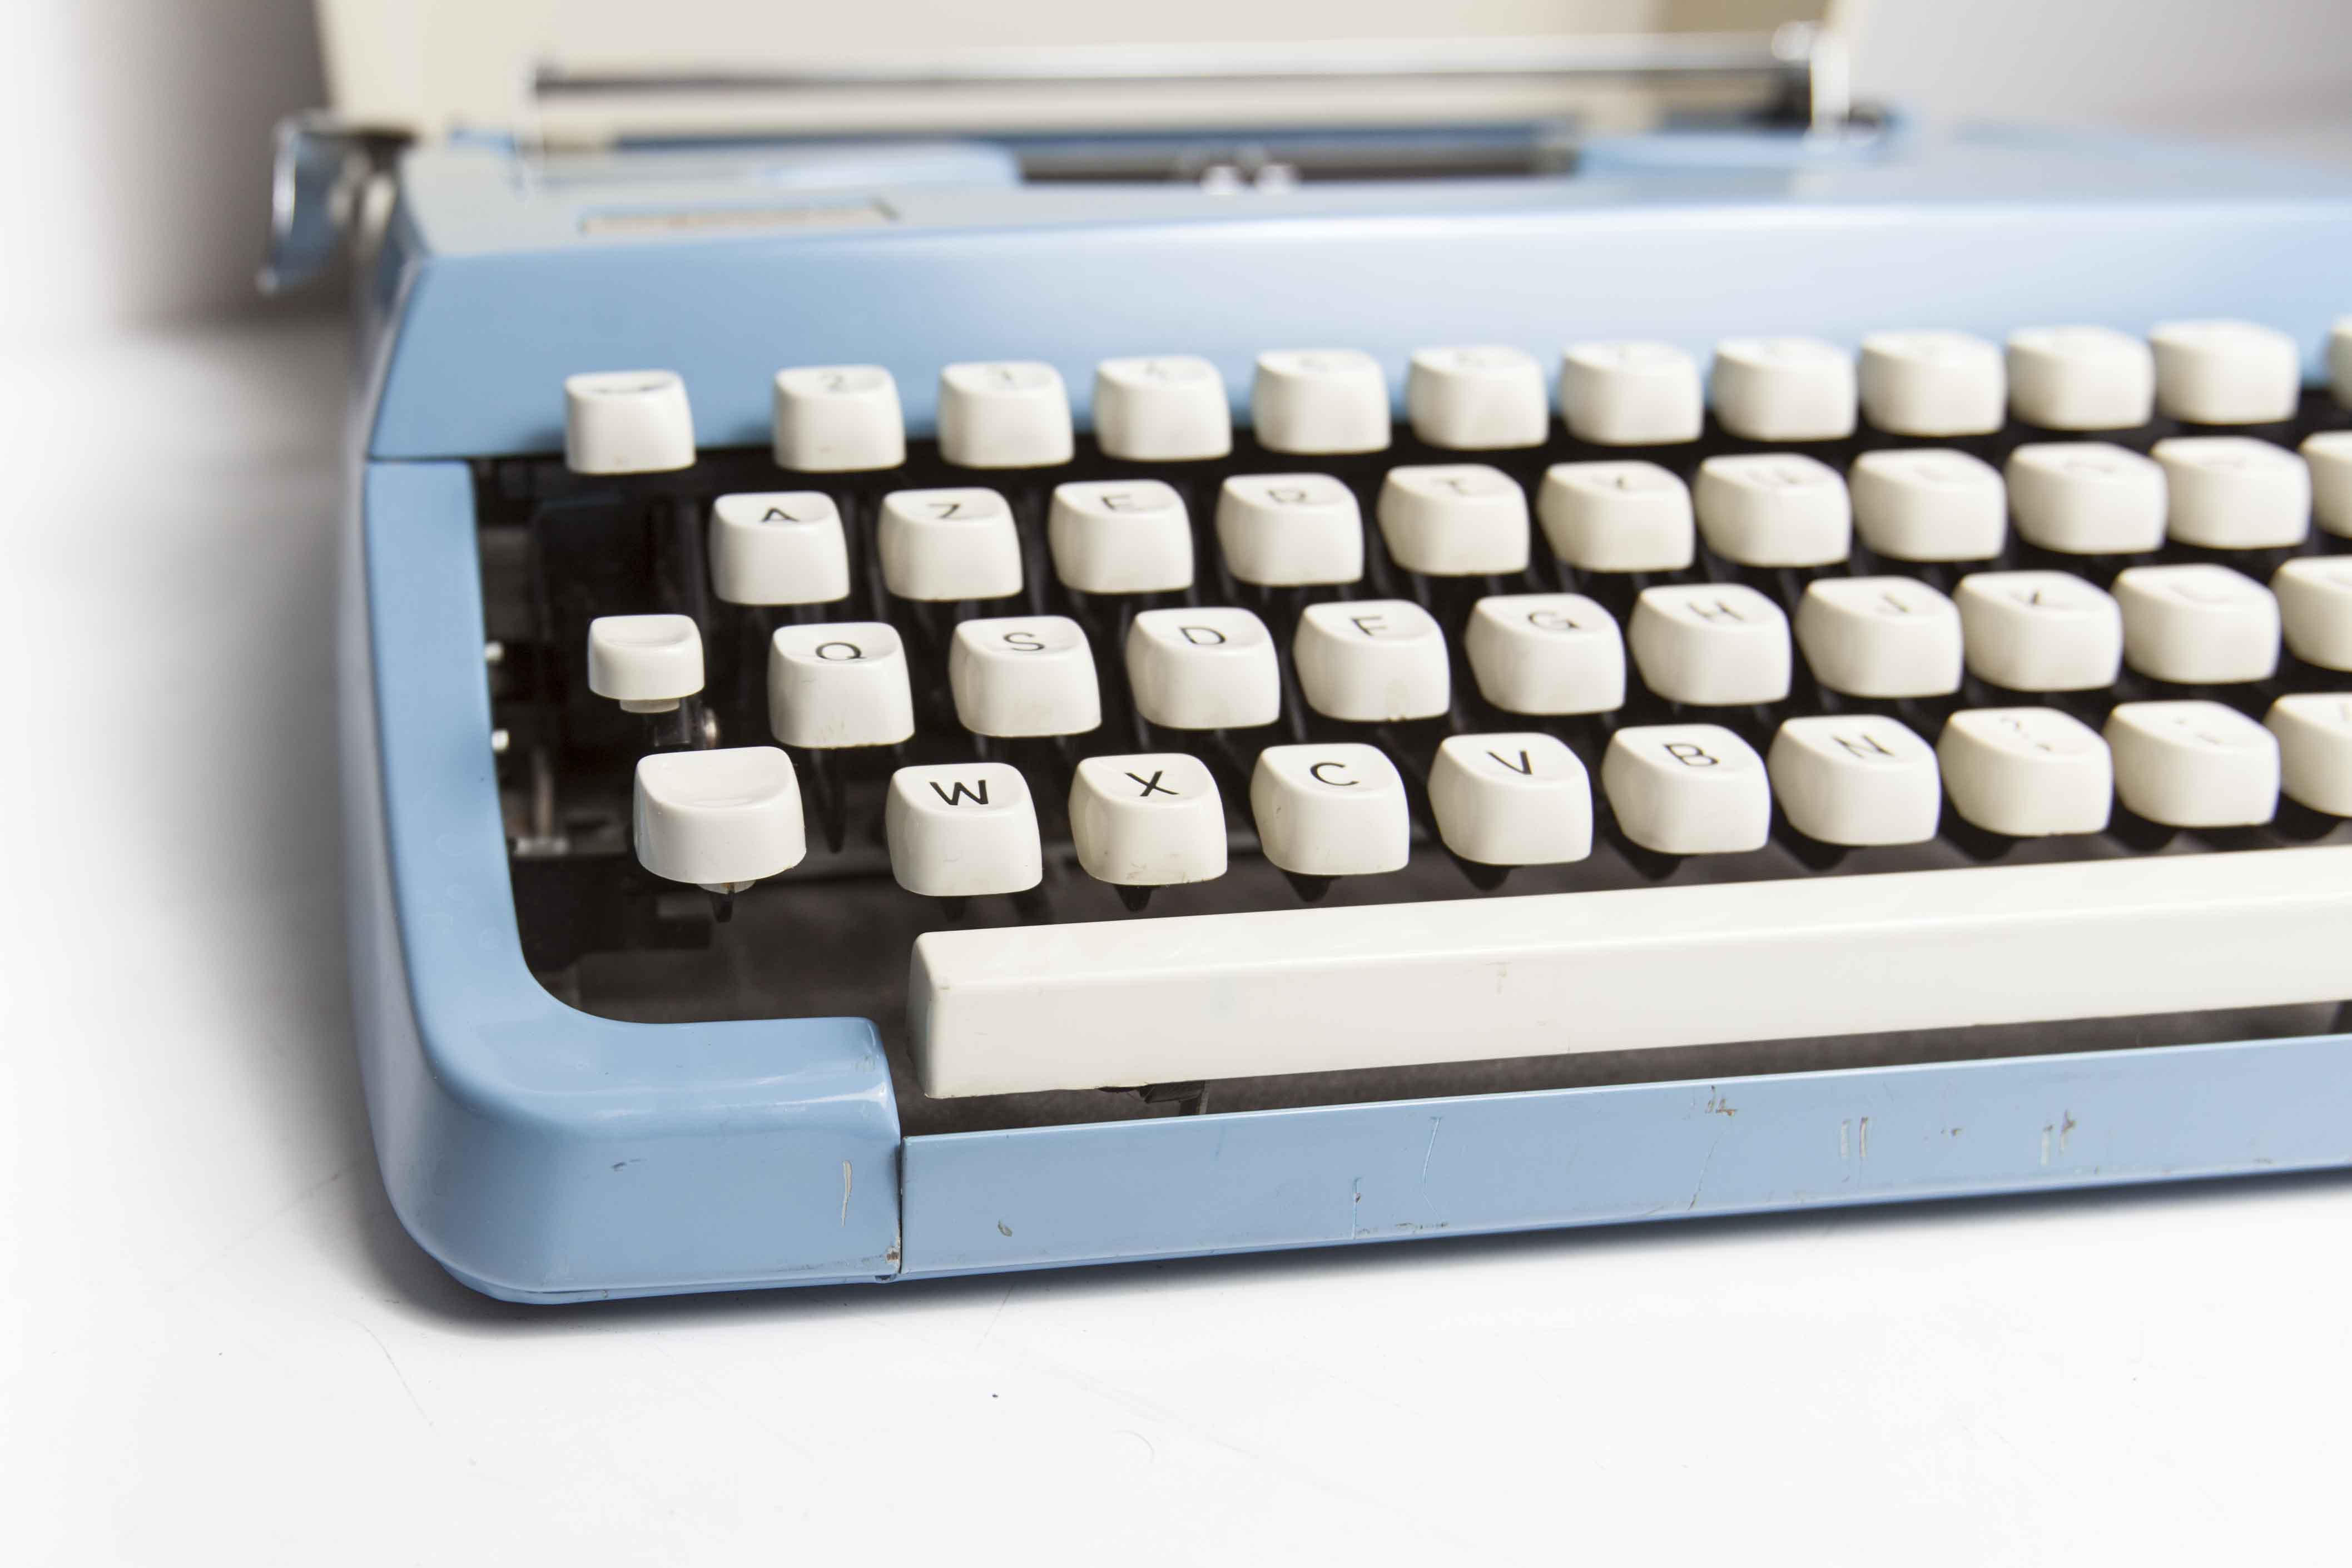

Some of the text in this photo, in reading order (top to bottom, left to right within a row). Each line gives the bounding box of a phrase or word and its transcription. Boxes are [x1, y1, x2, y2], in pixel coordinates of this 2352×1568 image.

[760, 507, 800, 522] A
[927, 502, 965, 520] Z
[1351, 615, 1388, 636] F
[1527, 611, 1581, 631] G
[1003, 632, 1045, 651] S
[1180, 626, 1225, 645] D
[815, 642, 865, 663] Q
[1663, 743, 1719, 766] B
[1831, 734, 1896, 758] N
[1486, 750, 1533, 775] V
[1124, 770, 1179, 796] X
[1309, 762, 1360, 786] C
[930, 780, 989, 806] W
